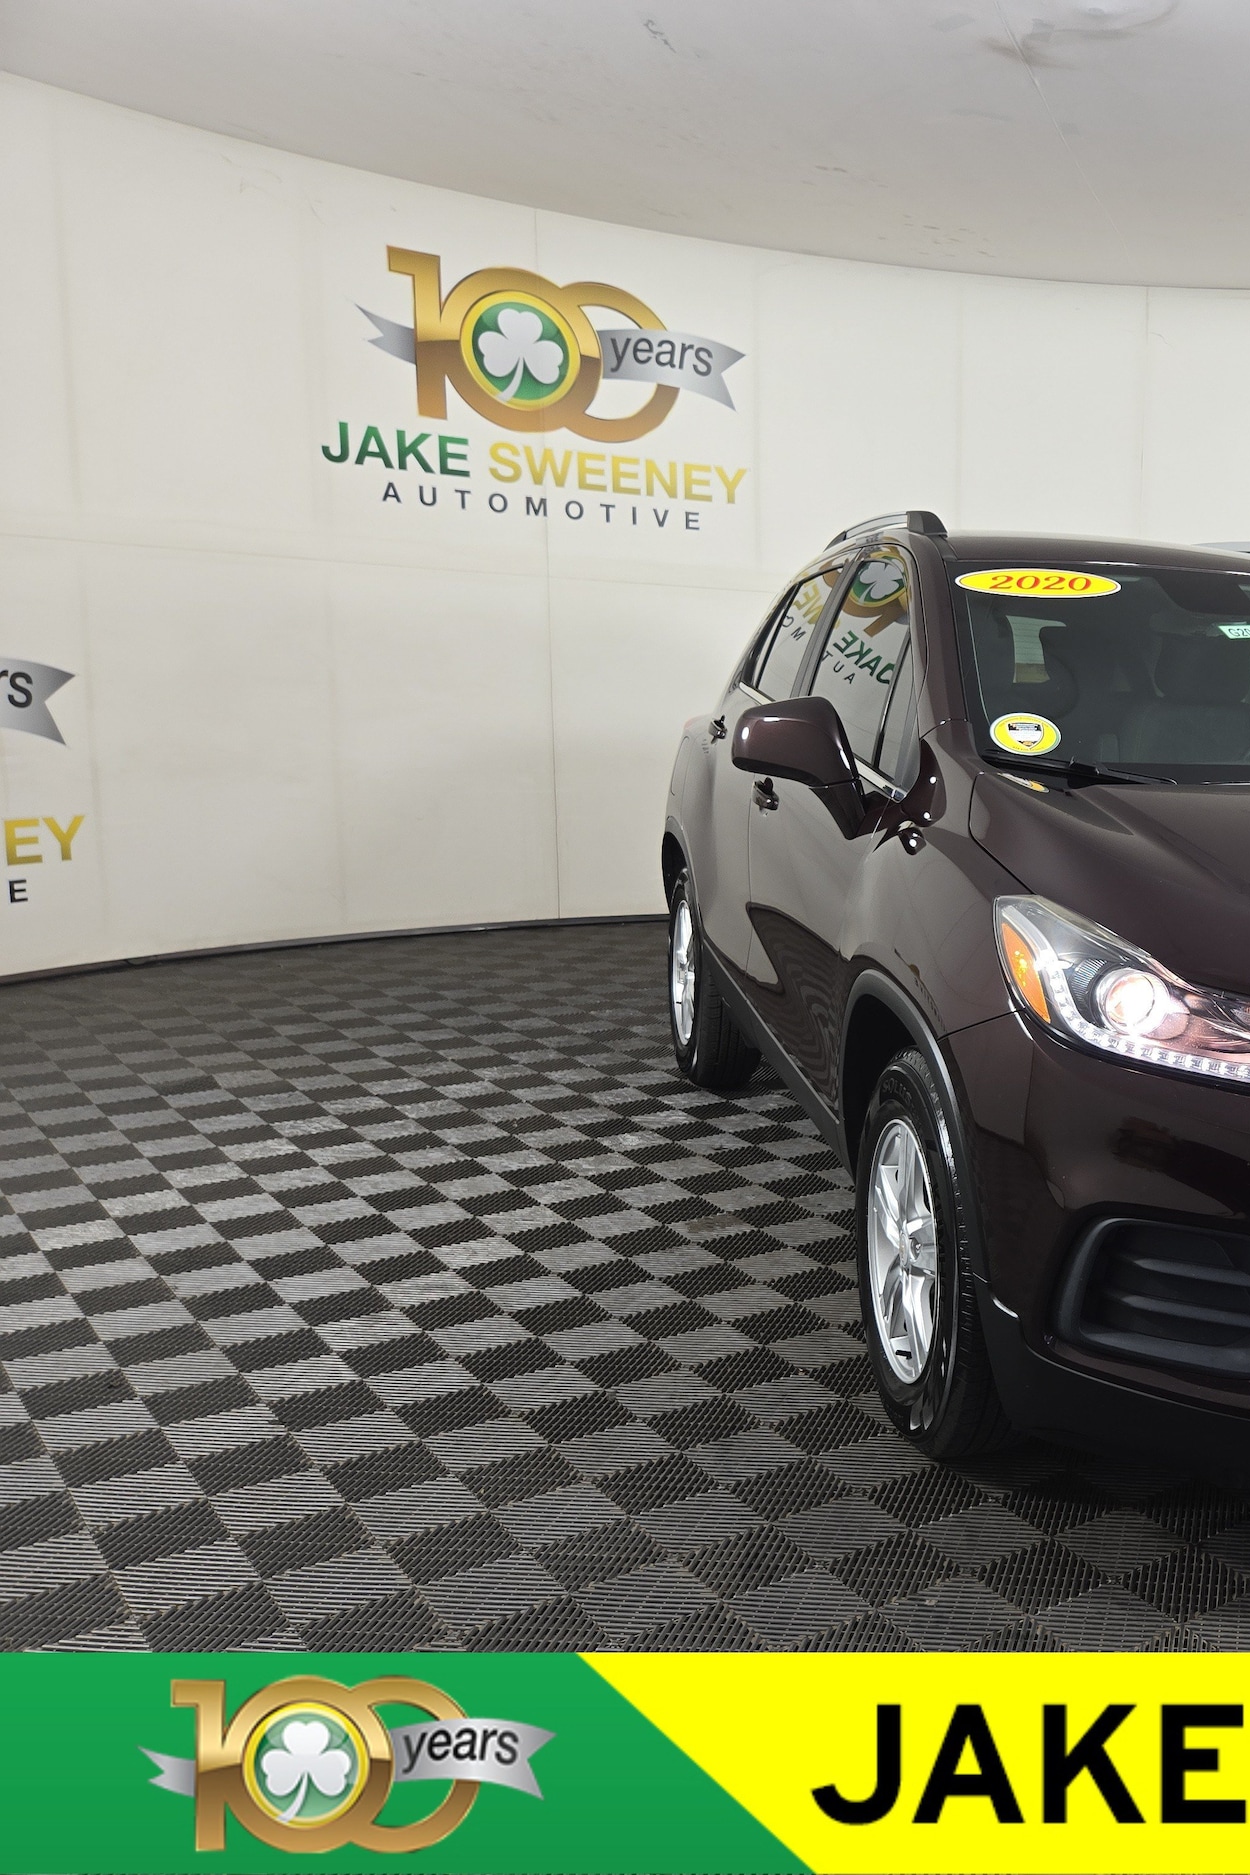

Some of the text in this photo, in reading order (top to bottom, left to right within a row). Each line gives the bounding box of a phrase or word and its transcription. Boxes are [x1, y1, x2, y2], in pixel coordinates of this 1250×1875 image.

[387, 245, 714, 443] 100 years
[321, 421, 748, 504] JAKE SWEENEY
[382, 482, 701, 530] AUTOMOTIVE
[989, 575, 1092, 591] 2020
